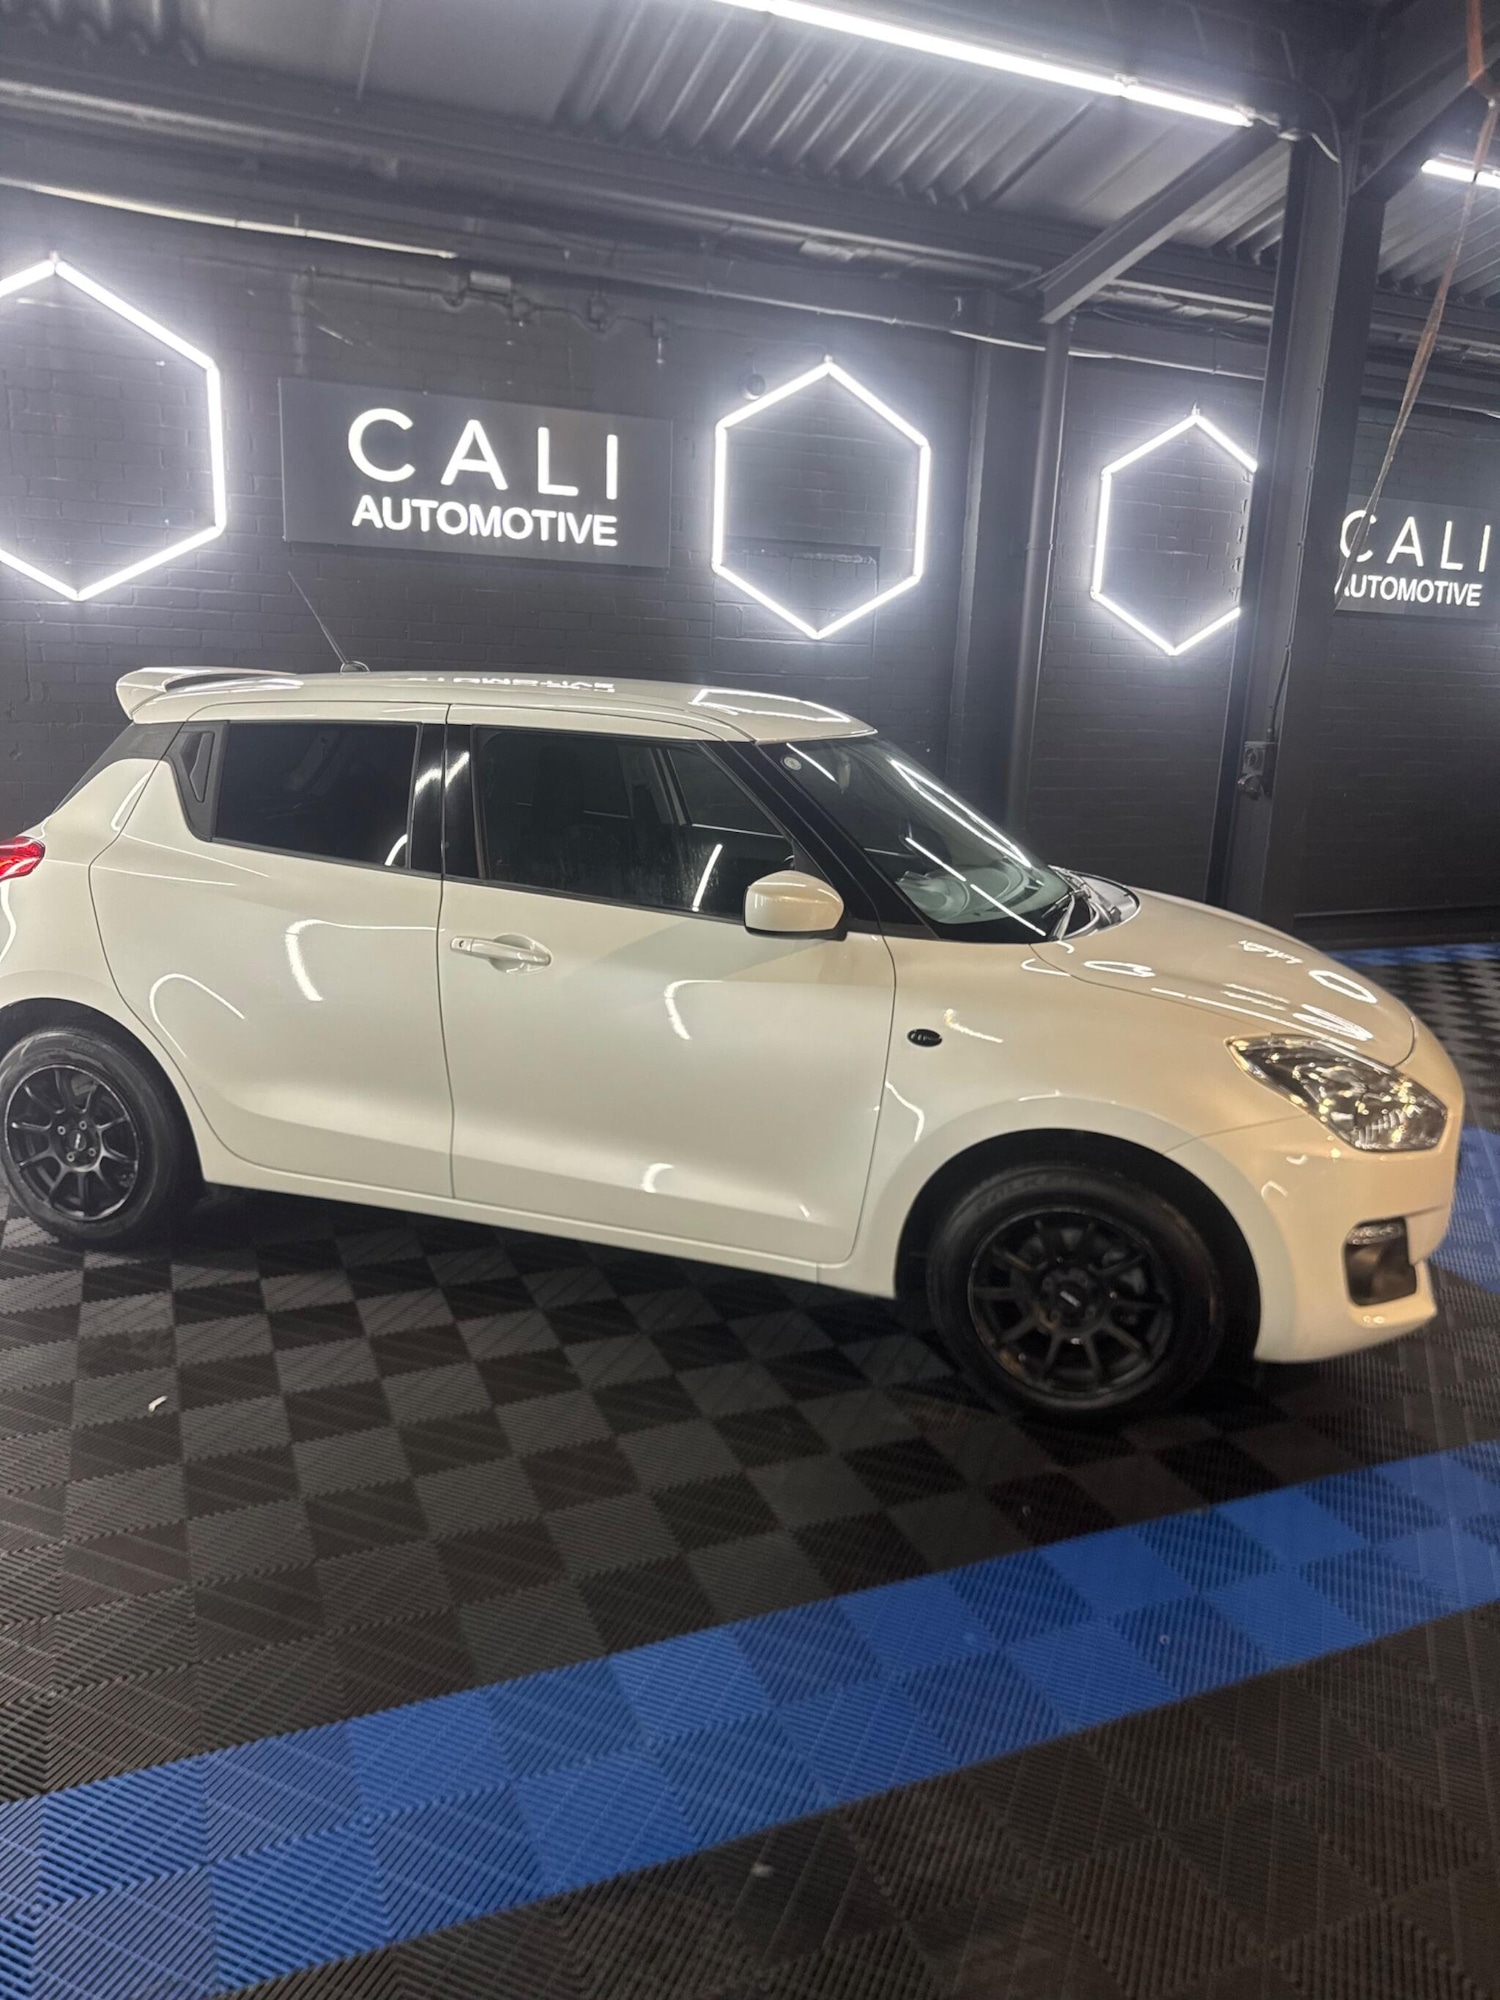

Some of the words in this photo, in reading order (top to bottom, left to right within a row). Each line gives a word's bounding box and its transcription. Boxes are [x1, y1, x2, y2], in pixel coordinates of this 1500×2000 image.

[347, 407, 619, 501] CALI
[351, 494, 619, 547] AUTOMOTIVE
[1339, 509, 1492, 573] CALI
